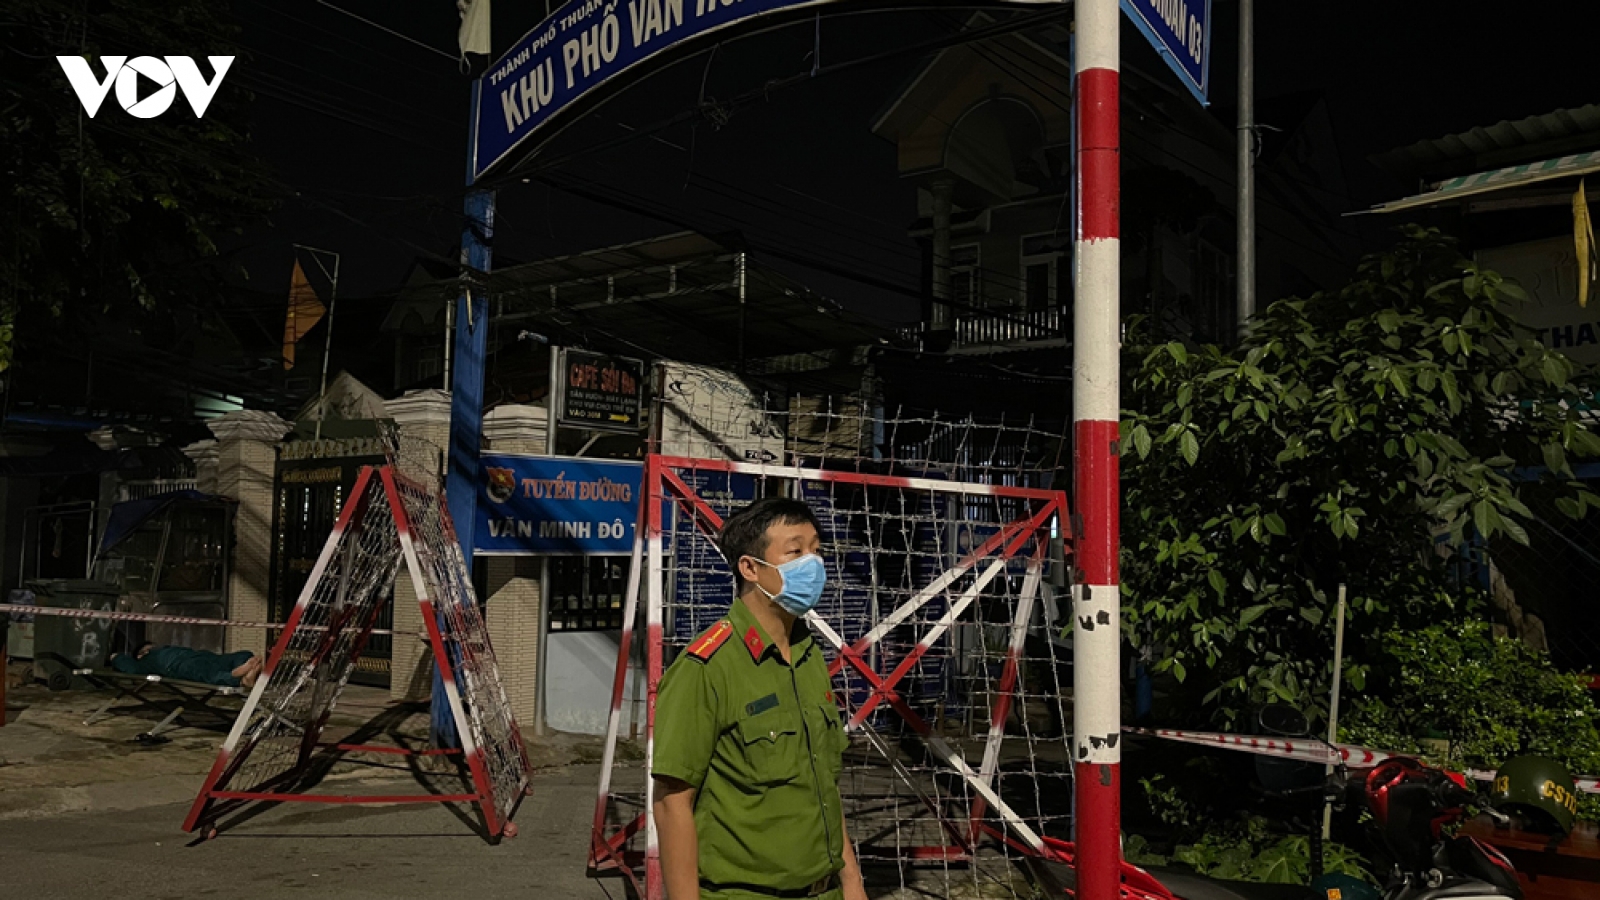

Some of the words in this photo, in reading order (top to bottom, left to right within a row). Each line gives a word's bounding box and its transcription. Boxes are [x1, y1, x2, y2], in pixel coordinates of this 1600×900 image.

[1188, 13, 1202, 65] 03
[500, 56, 555, 134] KHU
[1536, 322, 1600, 348] THA
[521, 470, 577, 499] TUYẾN
[579, 477, 632, 502] ĐƯỜNG
[487, 516, 533, 538] VĂN
[538, 519, 592, 539] MINH
[597, 517, 625, 539] ĐÔ
